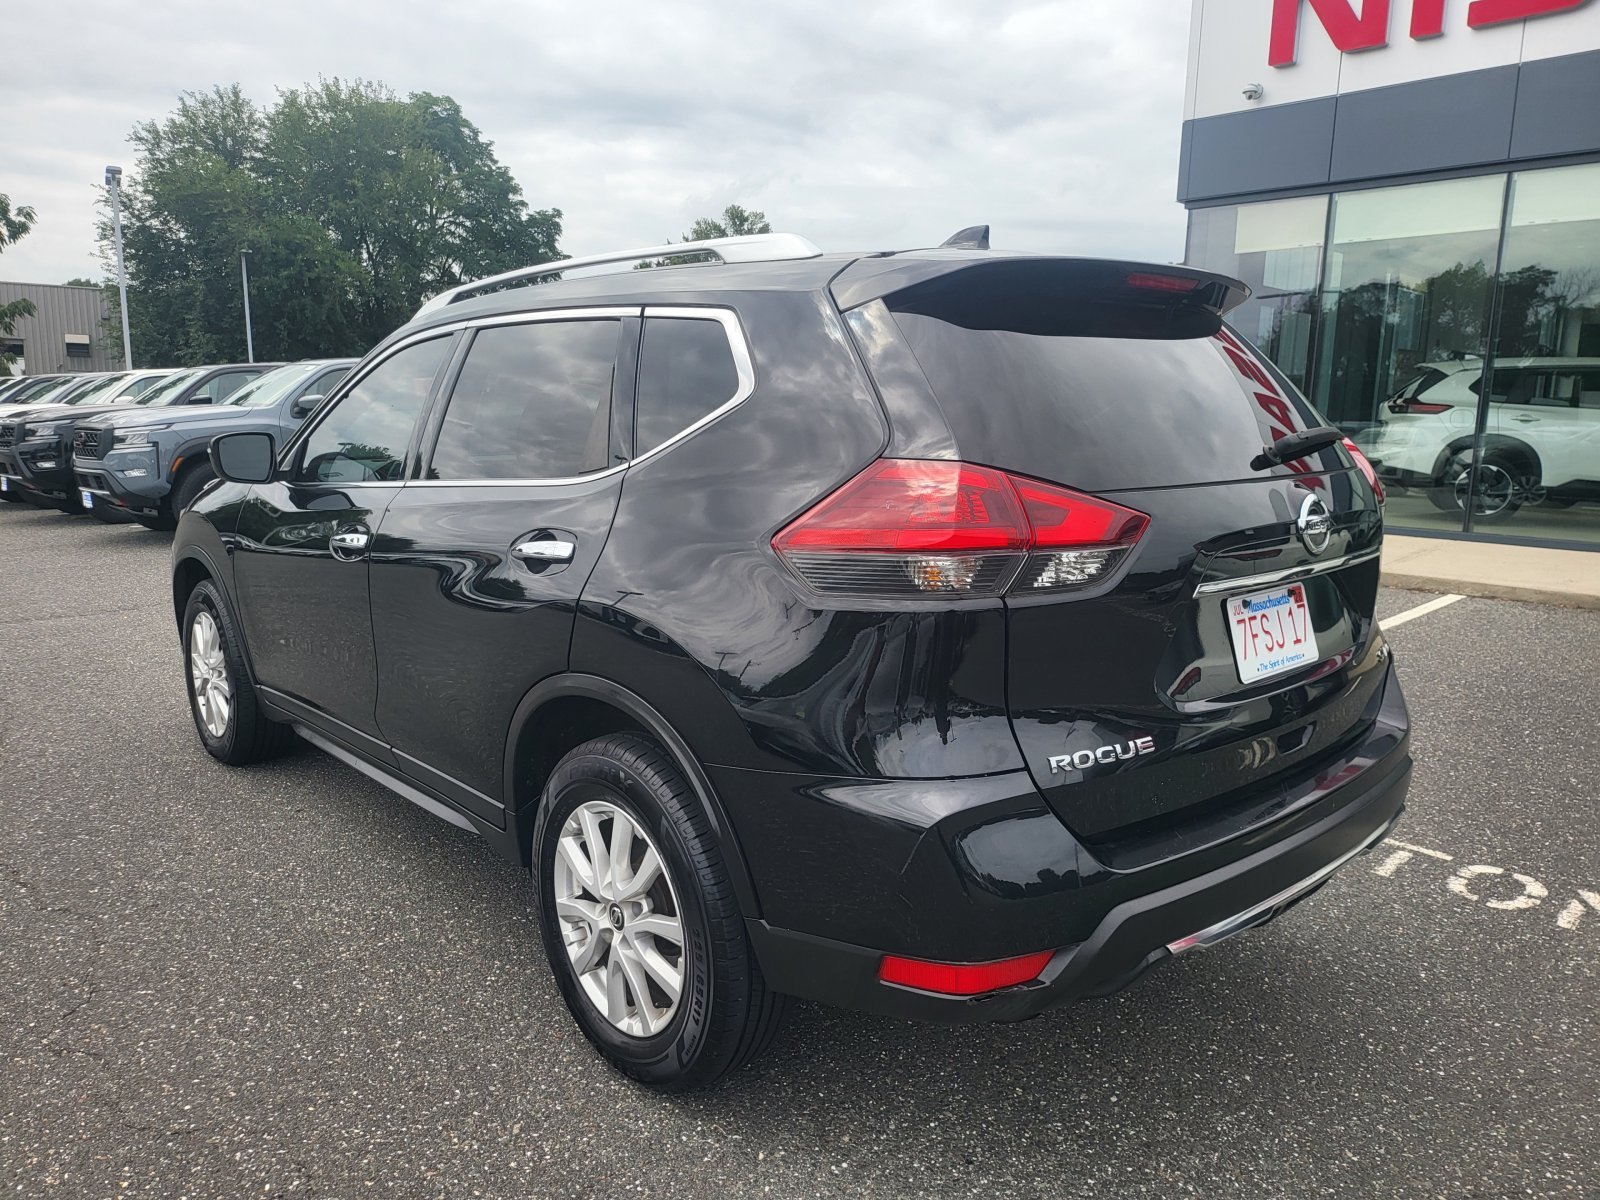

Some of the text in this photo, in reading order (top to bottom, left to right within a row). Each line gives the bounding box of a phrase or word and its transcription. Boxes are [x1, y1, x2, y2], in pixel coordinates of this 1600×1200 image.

[1247, 595, 1290, 613] Massachusetts
[1259, 662, 1268, 672] The
[1268, 659, 1280, 670] Spirit
[1285, 653, 1303, 664] America
[1047, 735, 1156, 774] ROGUE
